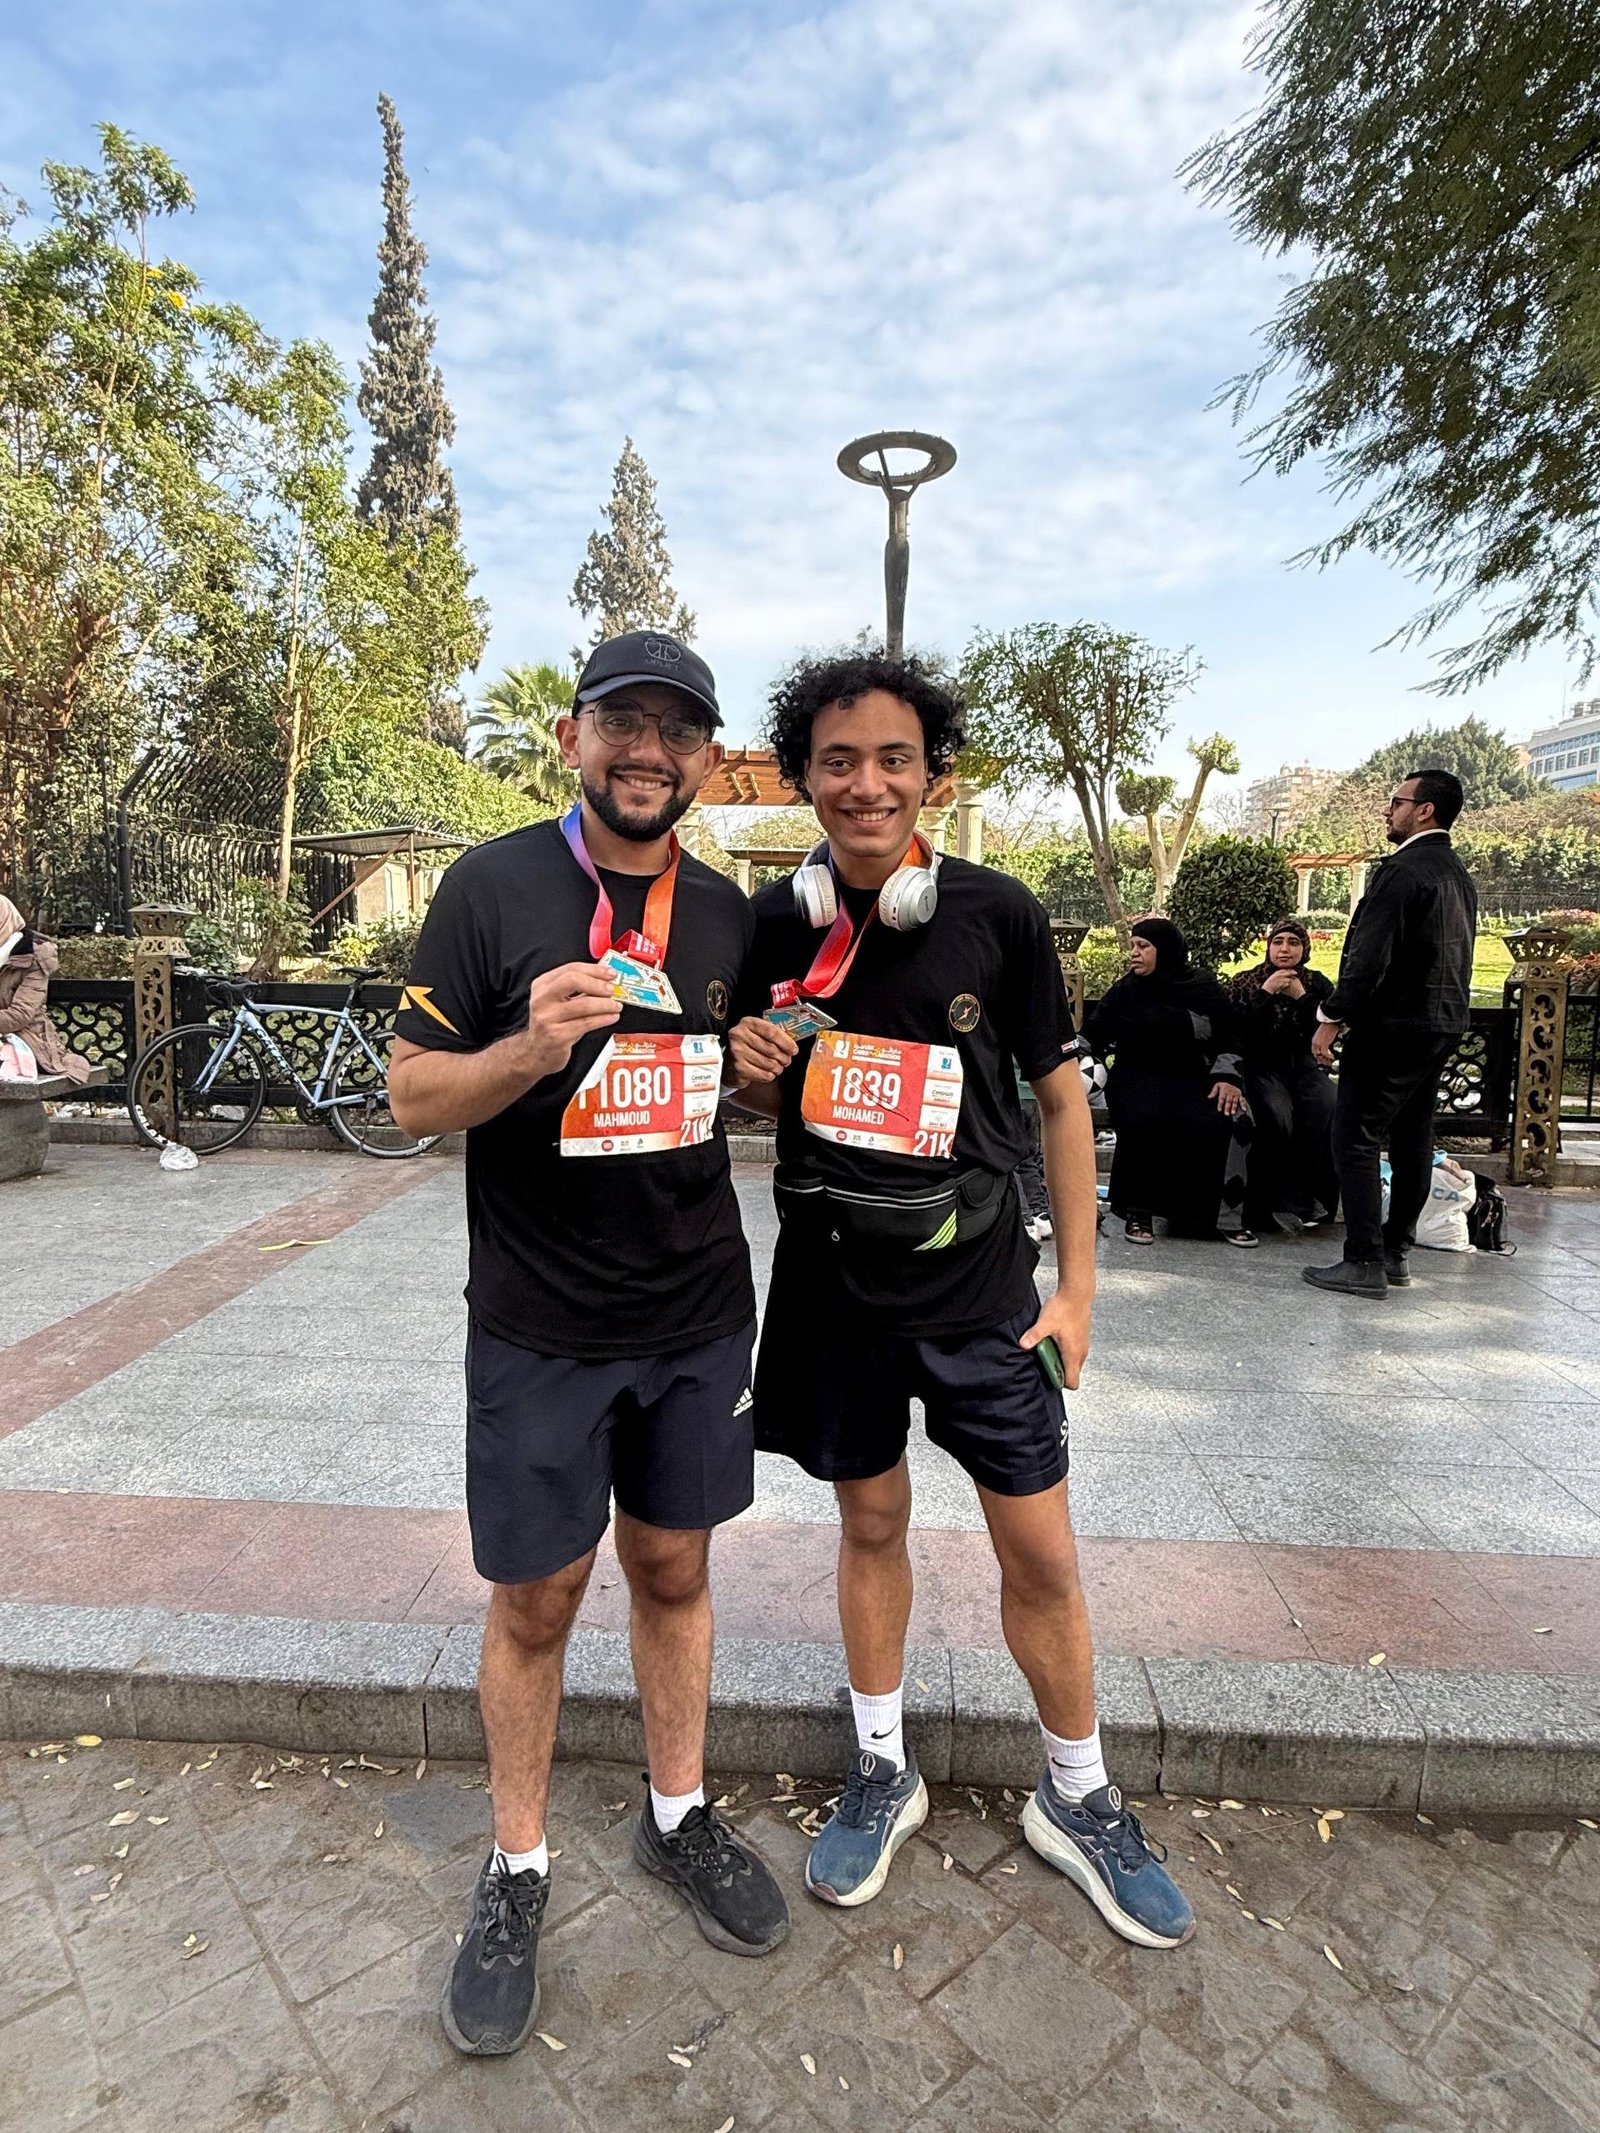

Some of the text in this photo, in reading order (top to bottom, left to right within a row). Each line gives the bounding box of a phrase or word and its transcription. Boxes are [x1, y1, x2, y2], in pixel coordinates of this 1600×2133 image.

[831, 1065, 902, 1111] 1839
[593, 1111, 650, 1128] MAHMOUD
[832, 1105, 885, 1125] MOHAMED
[912, 1130, 955, 1159] 21K
